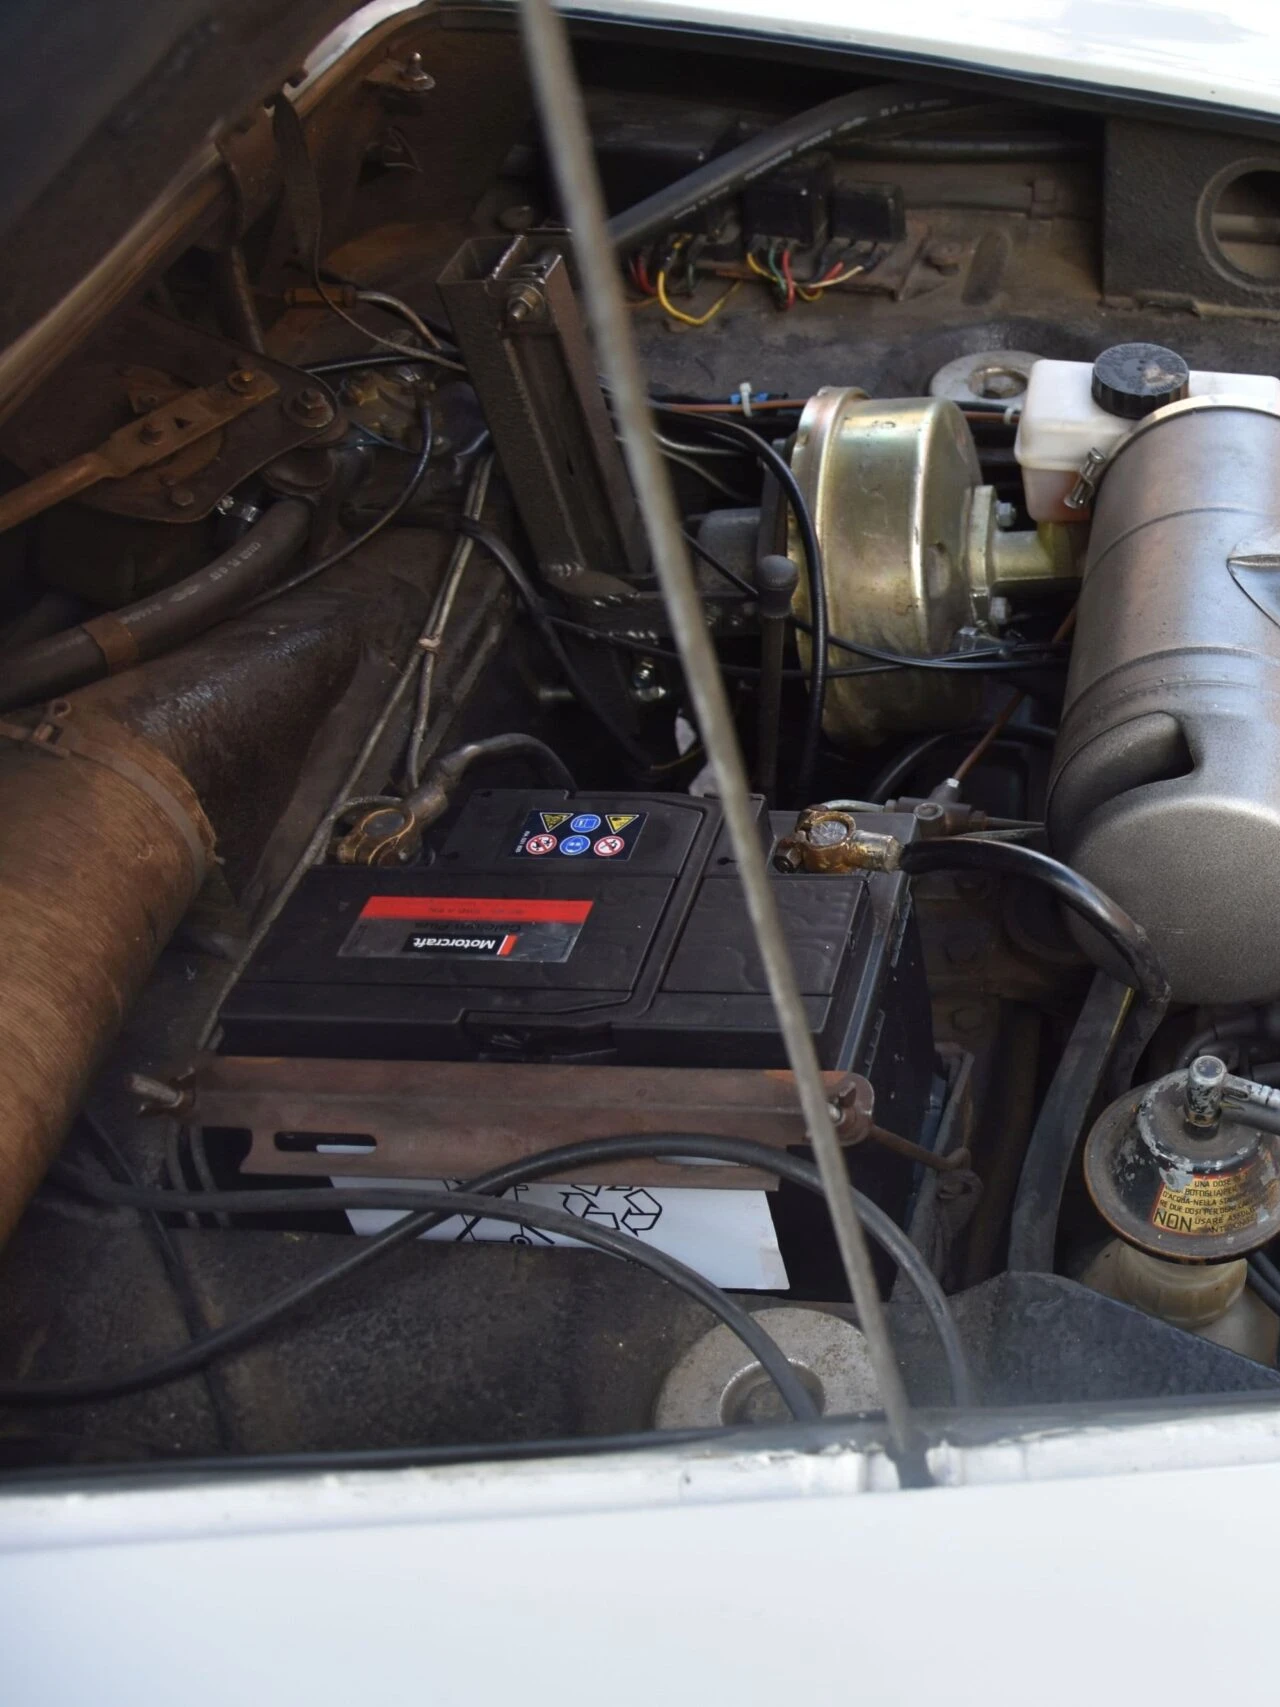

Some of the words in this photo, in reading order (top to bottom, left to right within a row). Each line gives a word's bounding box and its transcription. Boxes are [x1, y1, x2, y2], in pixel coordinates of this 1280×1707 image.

[413, 938, 496, 950] Motorcraft
[1153, 1208, 1192, 1232] NON
[1195, 1215, 1224, 1225] USARE
